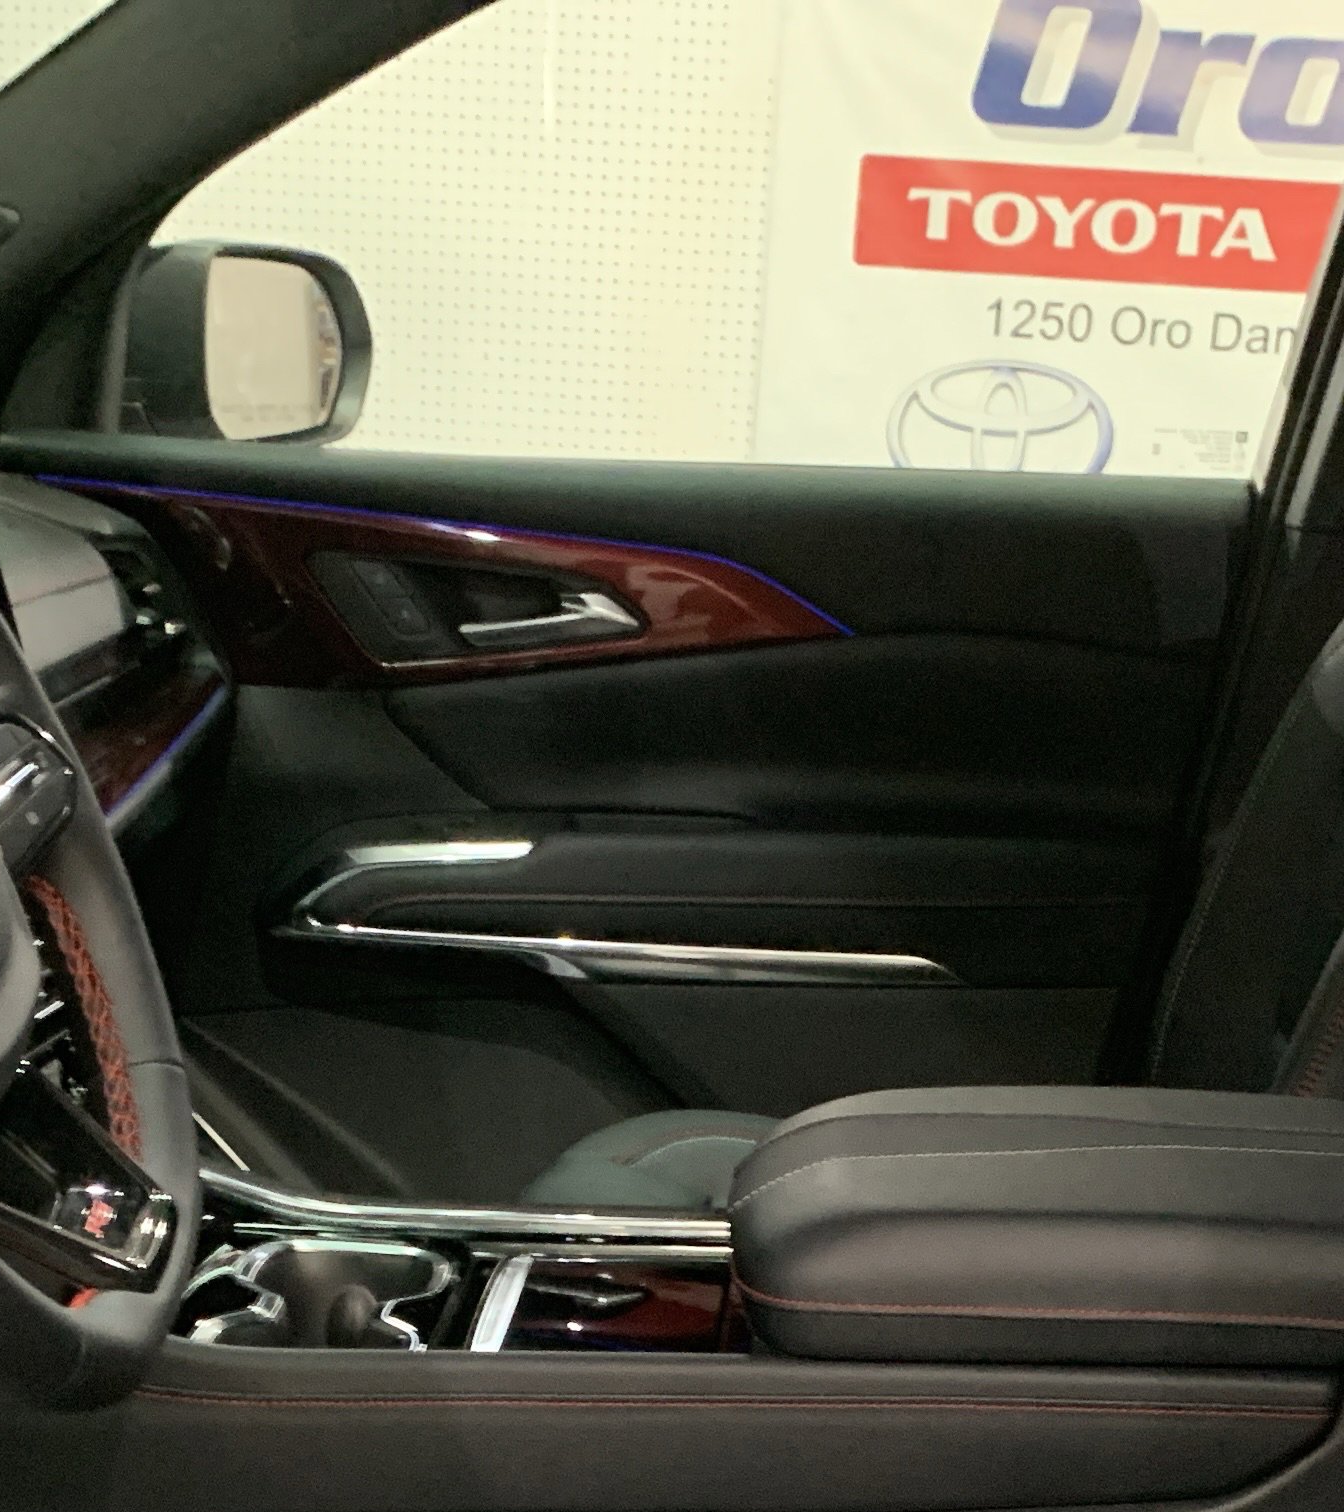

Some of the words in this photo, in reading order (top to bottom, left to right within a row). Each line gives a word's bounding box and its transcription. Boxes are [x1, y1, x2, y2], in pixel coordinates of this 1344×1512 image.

[907, 187, 1278, 262] TOYOTA
[986, 297, 1094, 344] 1250
[1110, 305, 1192, 350] Oro
